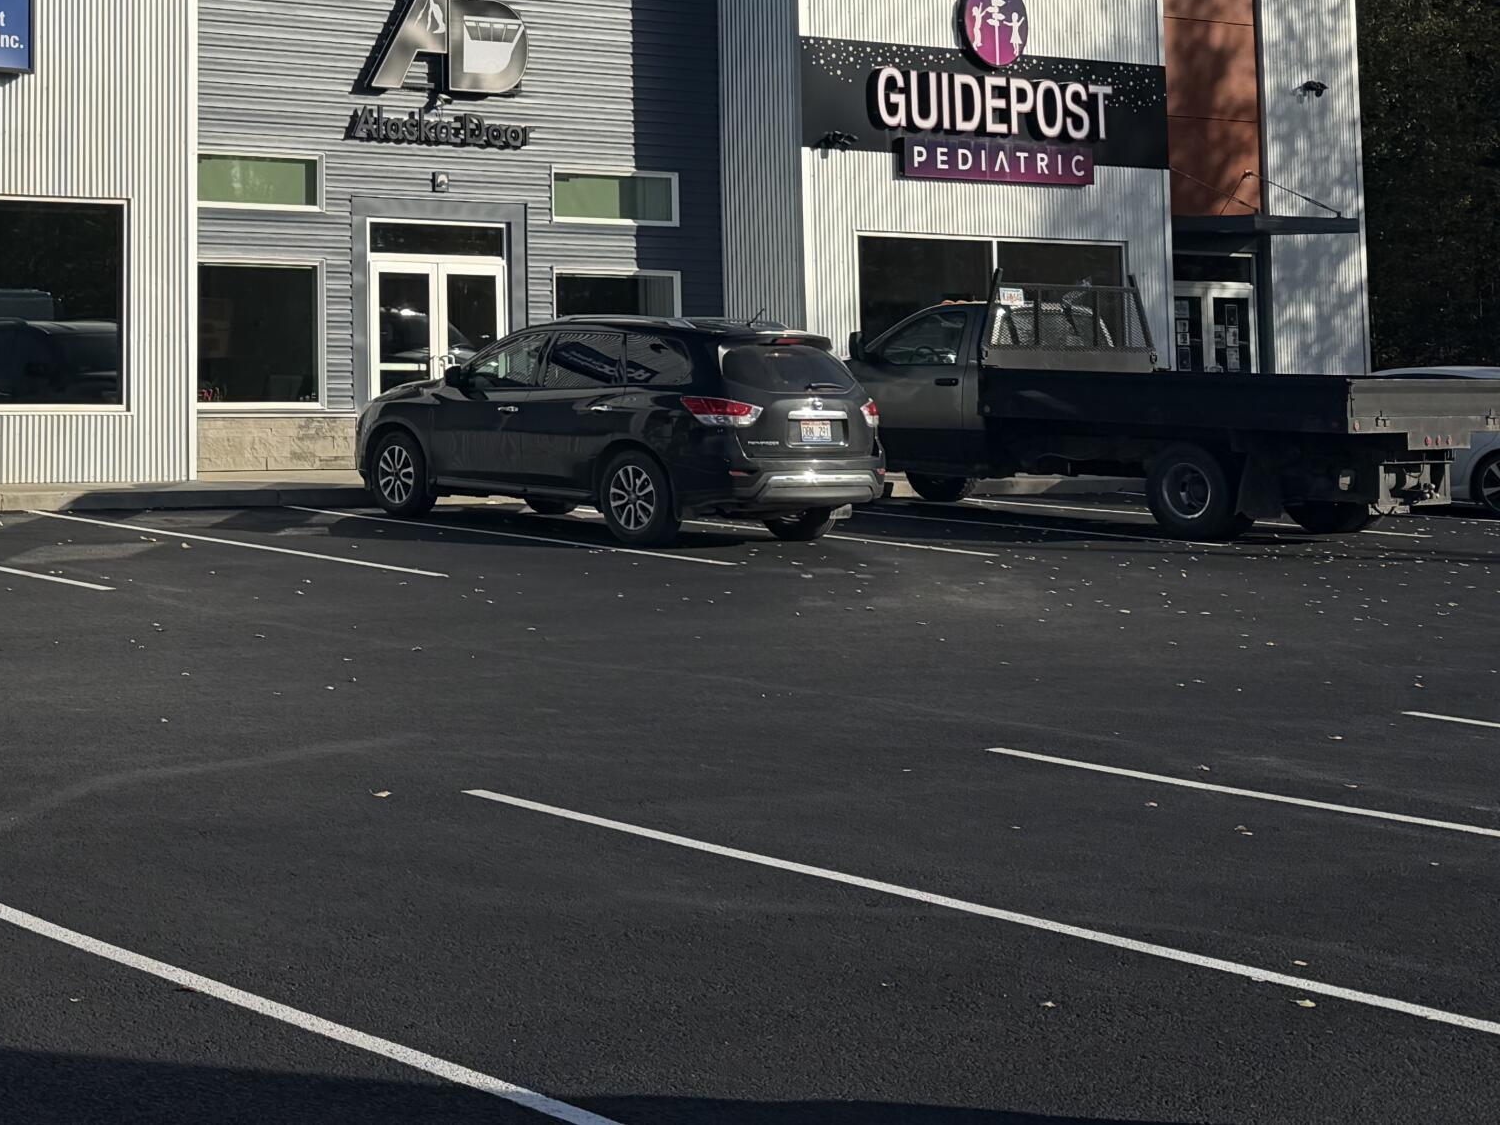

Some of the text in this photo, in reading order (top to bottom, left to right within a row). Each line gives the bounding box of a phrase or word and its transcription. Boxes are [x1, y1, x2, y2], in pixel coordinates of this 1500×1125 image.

[877, 65, 1113, 141] GUIDEPOST
[354, 105, 536, 148] Alaska Door
[913, 145, 1086, 176] PEDIATRIC
